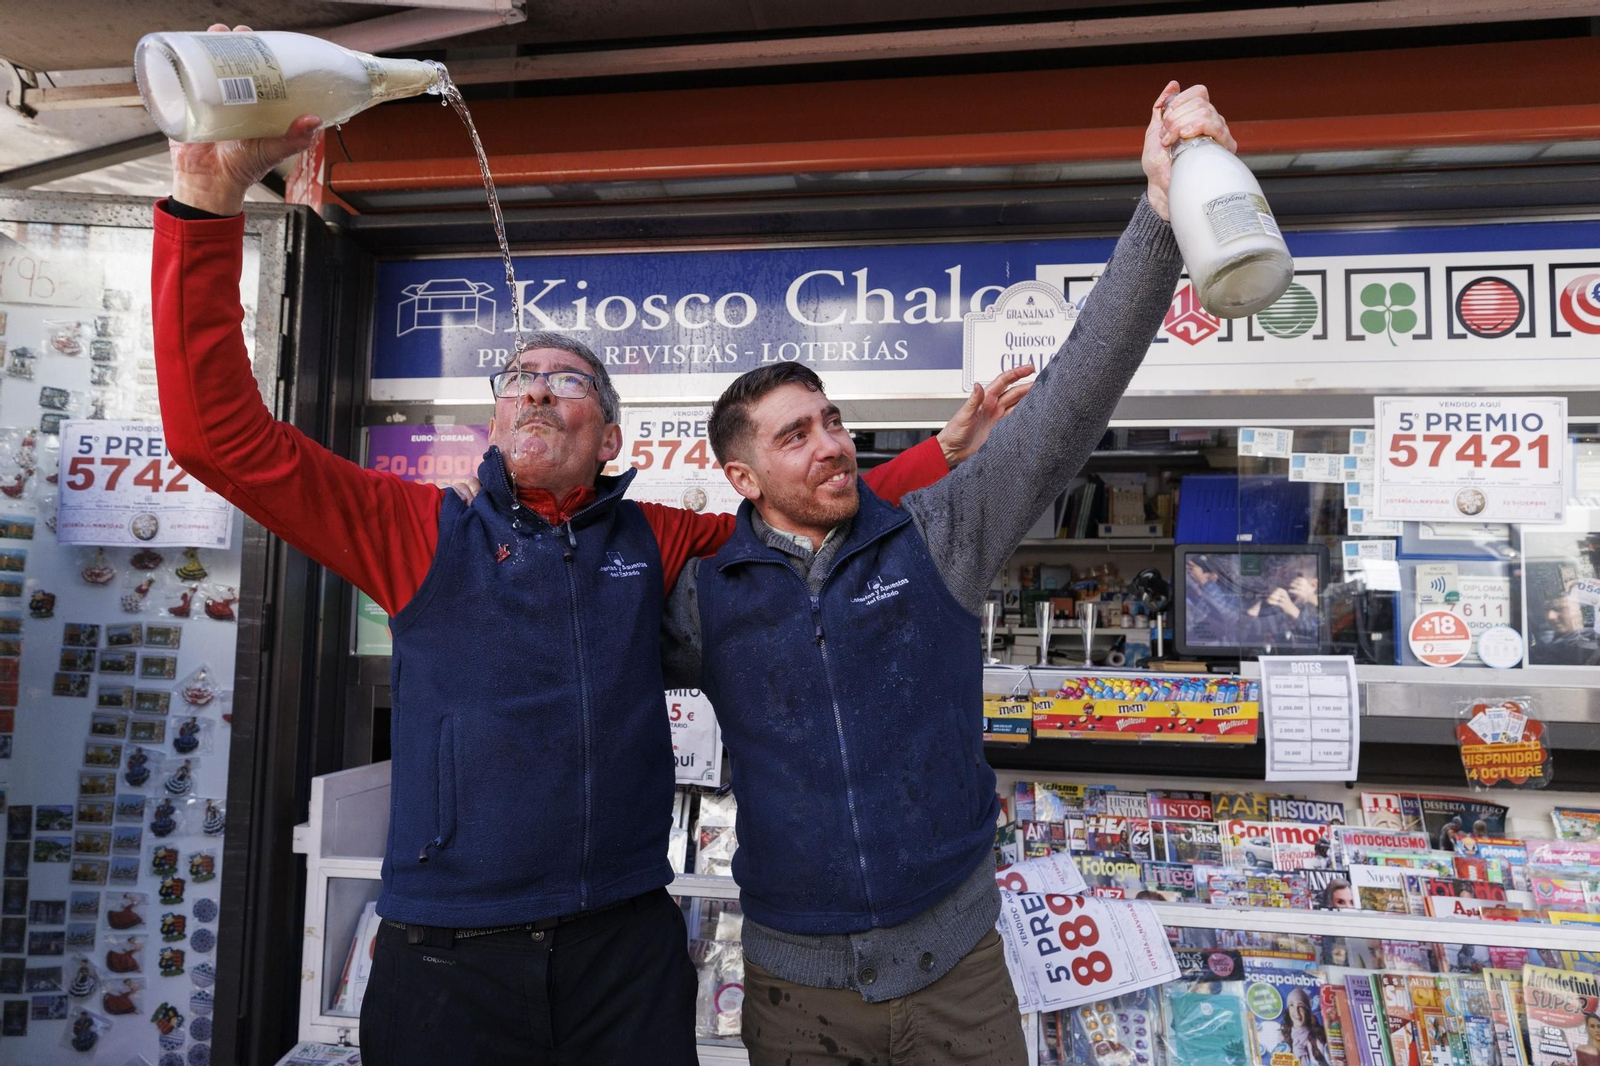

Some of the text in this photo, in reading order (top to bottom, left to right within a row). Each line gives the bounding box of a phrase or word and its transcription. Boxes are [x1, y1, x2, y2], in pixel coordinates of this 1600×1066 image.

[503, 264, 1009, 334] Kiosco Chalo
[1006, 308, 1055, 320] GRANAÍNAS
[1005, 331, 1056, 351] Quiosco
[604, 343, 738, 366] REVISTAS
[761, 335, 909, 363] LOTERÍAS
[121, 425, 159, 433] VENDIDO
[661, 421, 708, 438] PRE
[1426, 412, 1544, 433] PREMIO
[411, 434, 475, 442] EURO DREAMS
[105, 436, 169, 457] PRE
[1388, 433, 1549, 469] 57421
[630, 439, 723, 471] 574
[66, 456, 216, 493] 5742
[880, 578, 909, 593] Apuestas
[1463, 584, 1504, 592] DIPLOMA
[876, 590, 900, 601] Estado
[1421, 615, 1457, 635] +18
[1290, 662, 1322, 674] BOTES
[1116, 717, 1147, 732] Maltesers
[1217, 719, 1249, 734] Maltesers
[674, 753, 695, 768] QUÍ
[1462, 751, 1542, 766] HISPANIDAD
[1480, 765, 1544, 780] OCTUBRE
[1042, 783, 1078, 792] iclismo
[1110, 797, 1147, 808] HISTOR
[1423, 800, 1504, 814] DESPERTA FERRO
[1150, 803, 1212, 819] HISTOR
[1270, 799, 1344, 823] HISTORIA
[1088, 816, 1127, 834] HEA
[1132, 832, 1150, 845] 66
[1181, 826, 1221, 843] Clási
[1343, 834, 1426, 849] MOTOCICLISMO
[1081, 856, 1141, 883] Fotogra
[1144, 862, 1195, 890] integ
[1453, 900, 1480, 918] Apla
[1017, 891, 1062, 957] PRE
[1127, 903, 1143, 935] NAVIDAD
[1177, 959, 1205, 969] AUTY
[1527, 969, 1600, 999] Autodefinid
[1353, 989, 1372, 997] PUZ
